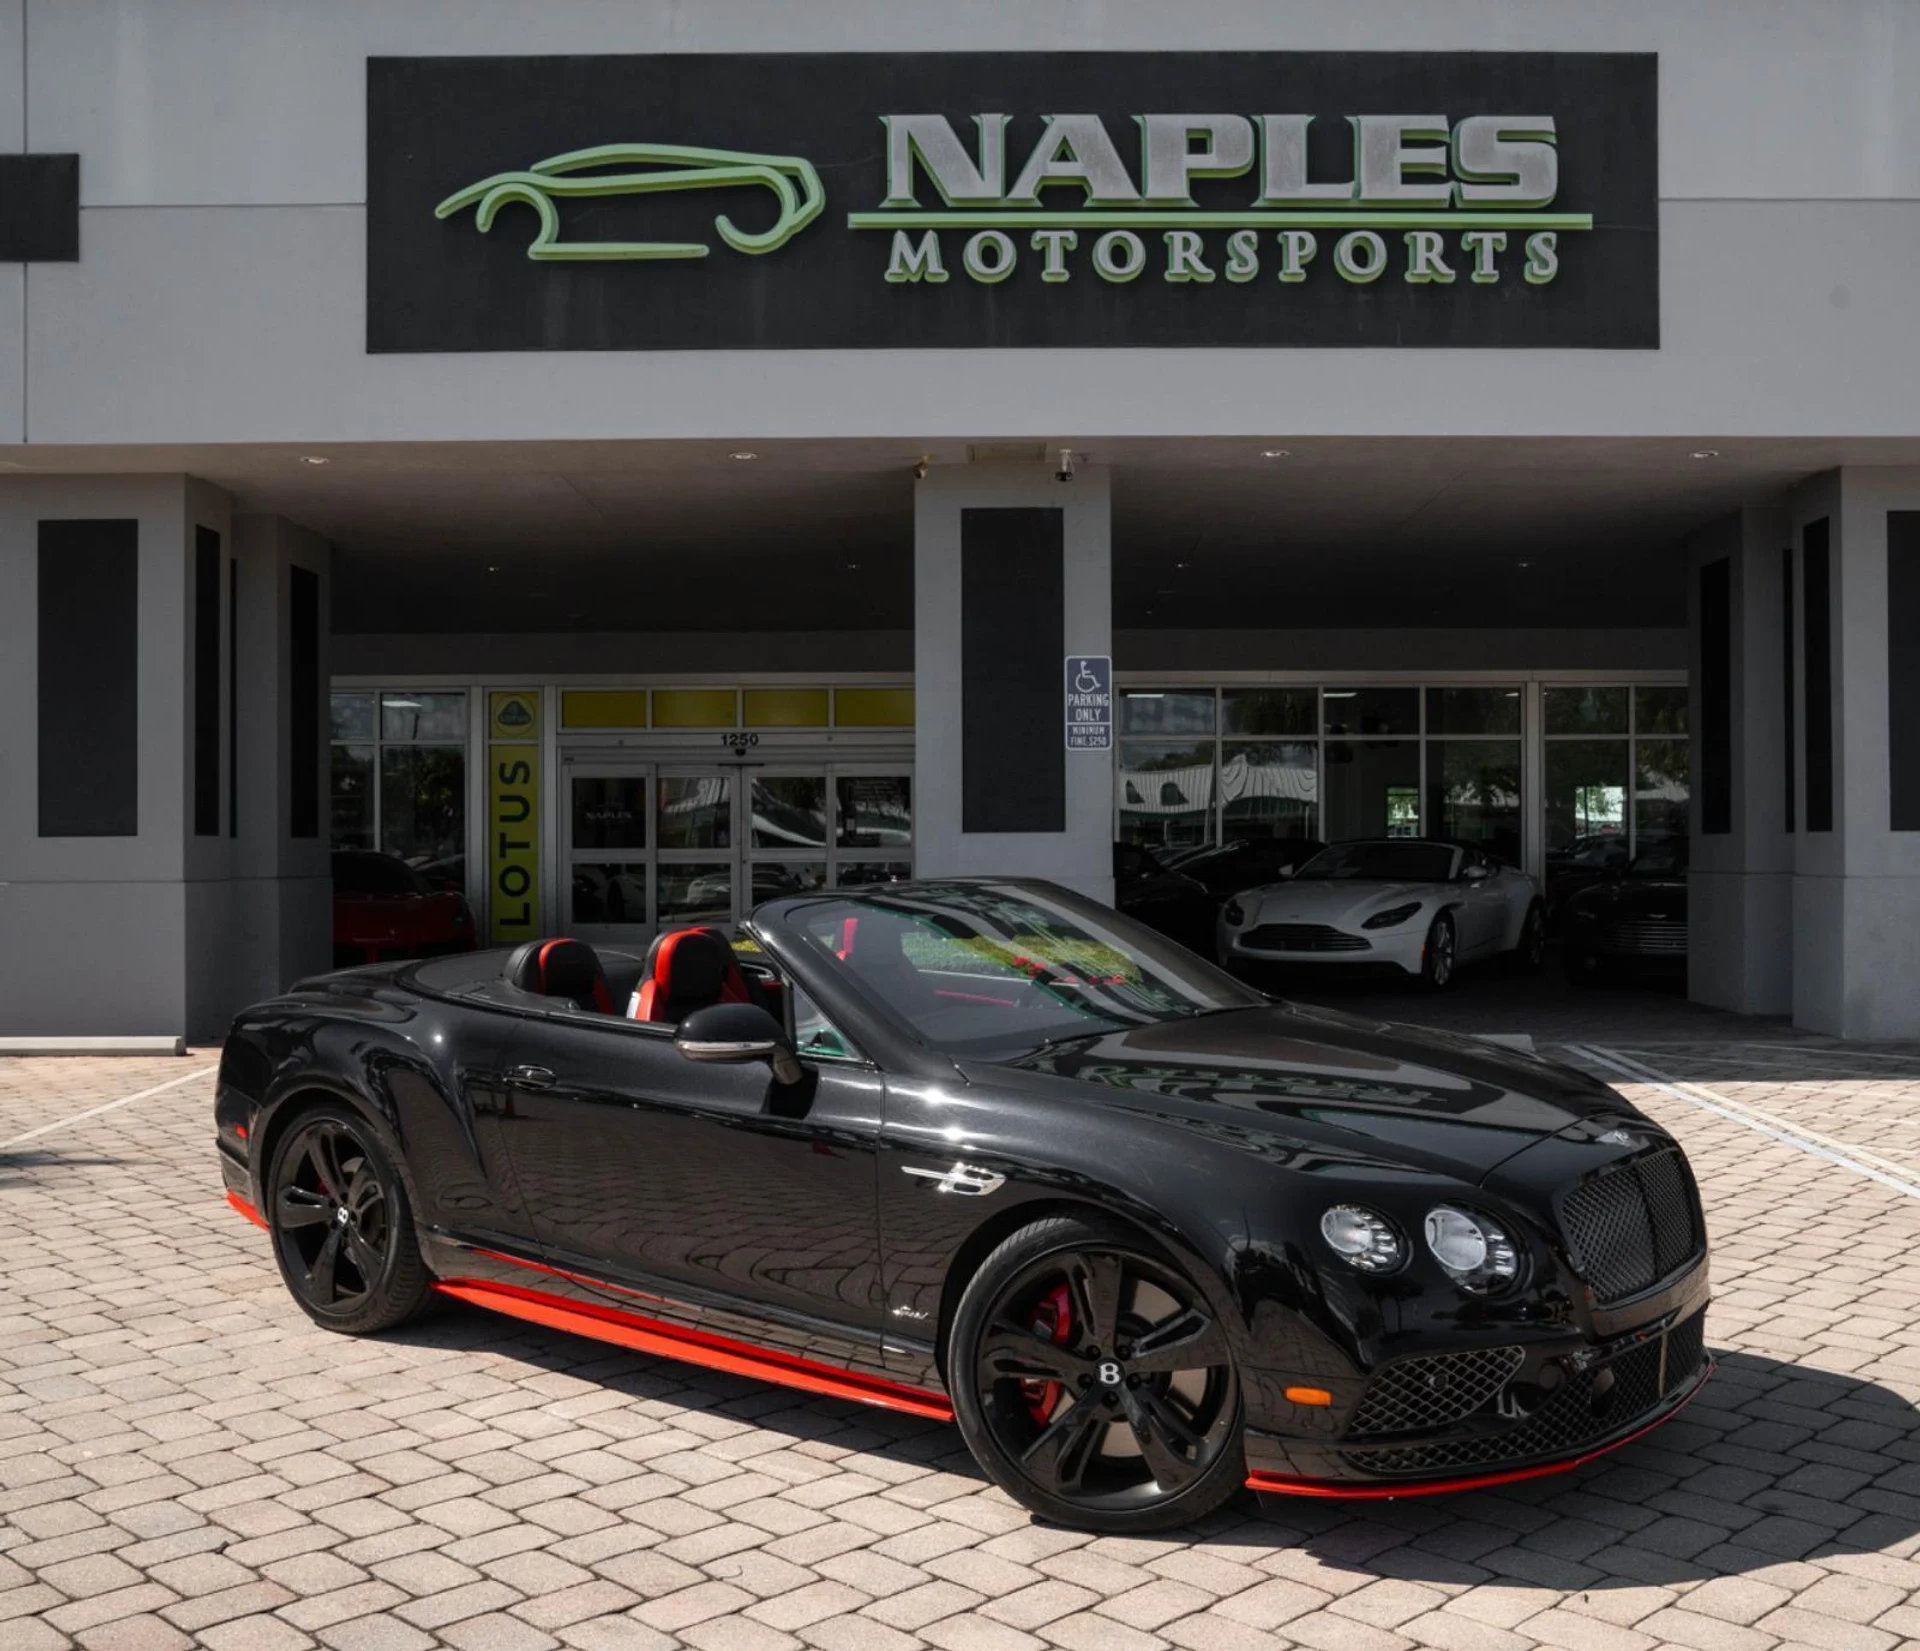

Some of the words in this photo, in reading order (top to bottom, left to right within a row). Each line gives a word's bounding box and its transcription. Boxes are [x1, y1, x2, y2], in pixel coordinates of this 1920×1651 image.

[878, 112, 1559, 209] NAPLES
[884, 229, 1560, 285] MOTORSPORTS
[1068, 693, 1109, 707] PARKING
[1075, 708, 1102, 722] ONLY
[721, 733, 759, 747] 1250
[498, 760, 531, 926] LOTUS
[1099, 1362, 1120, 1384] B
